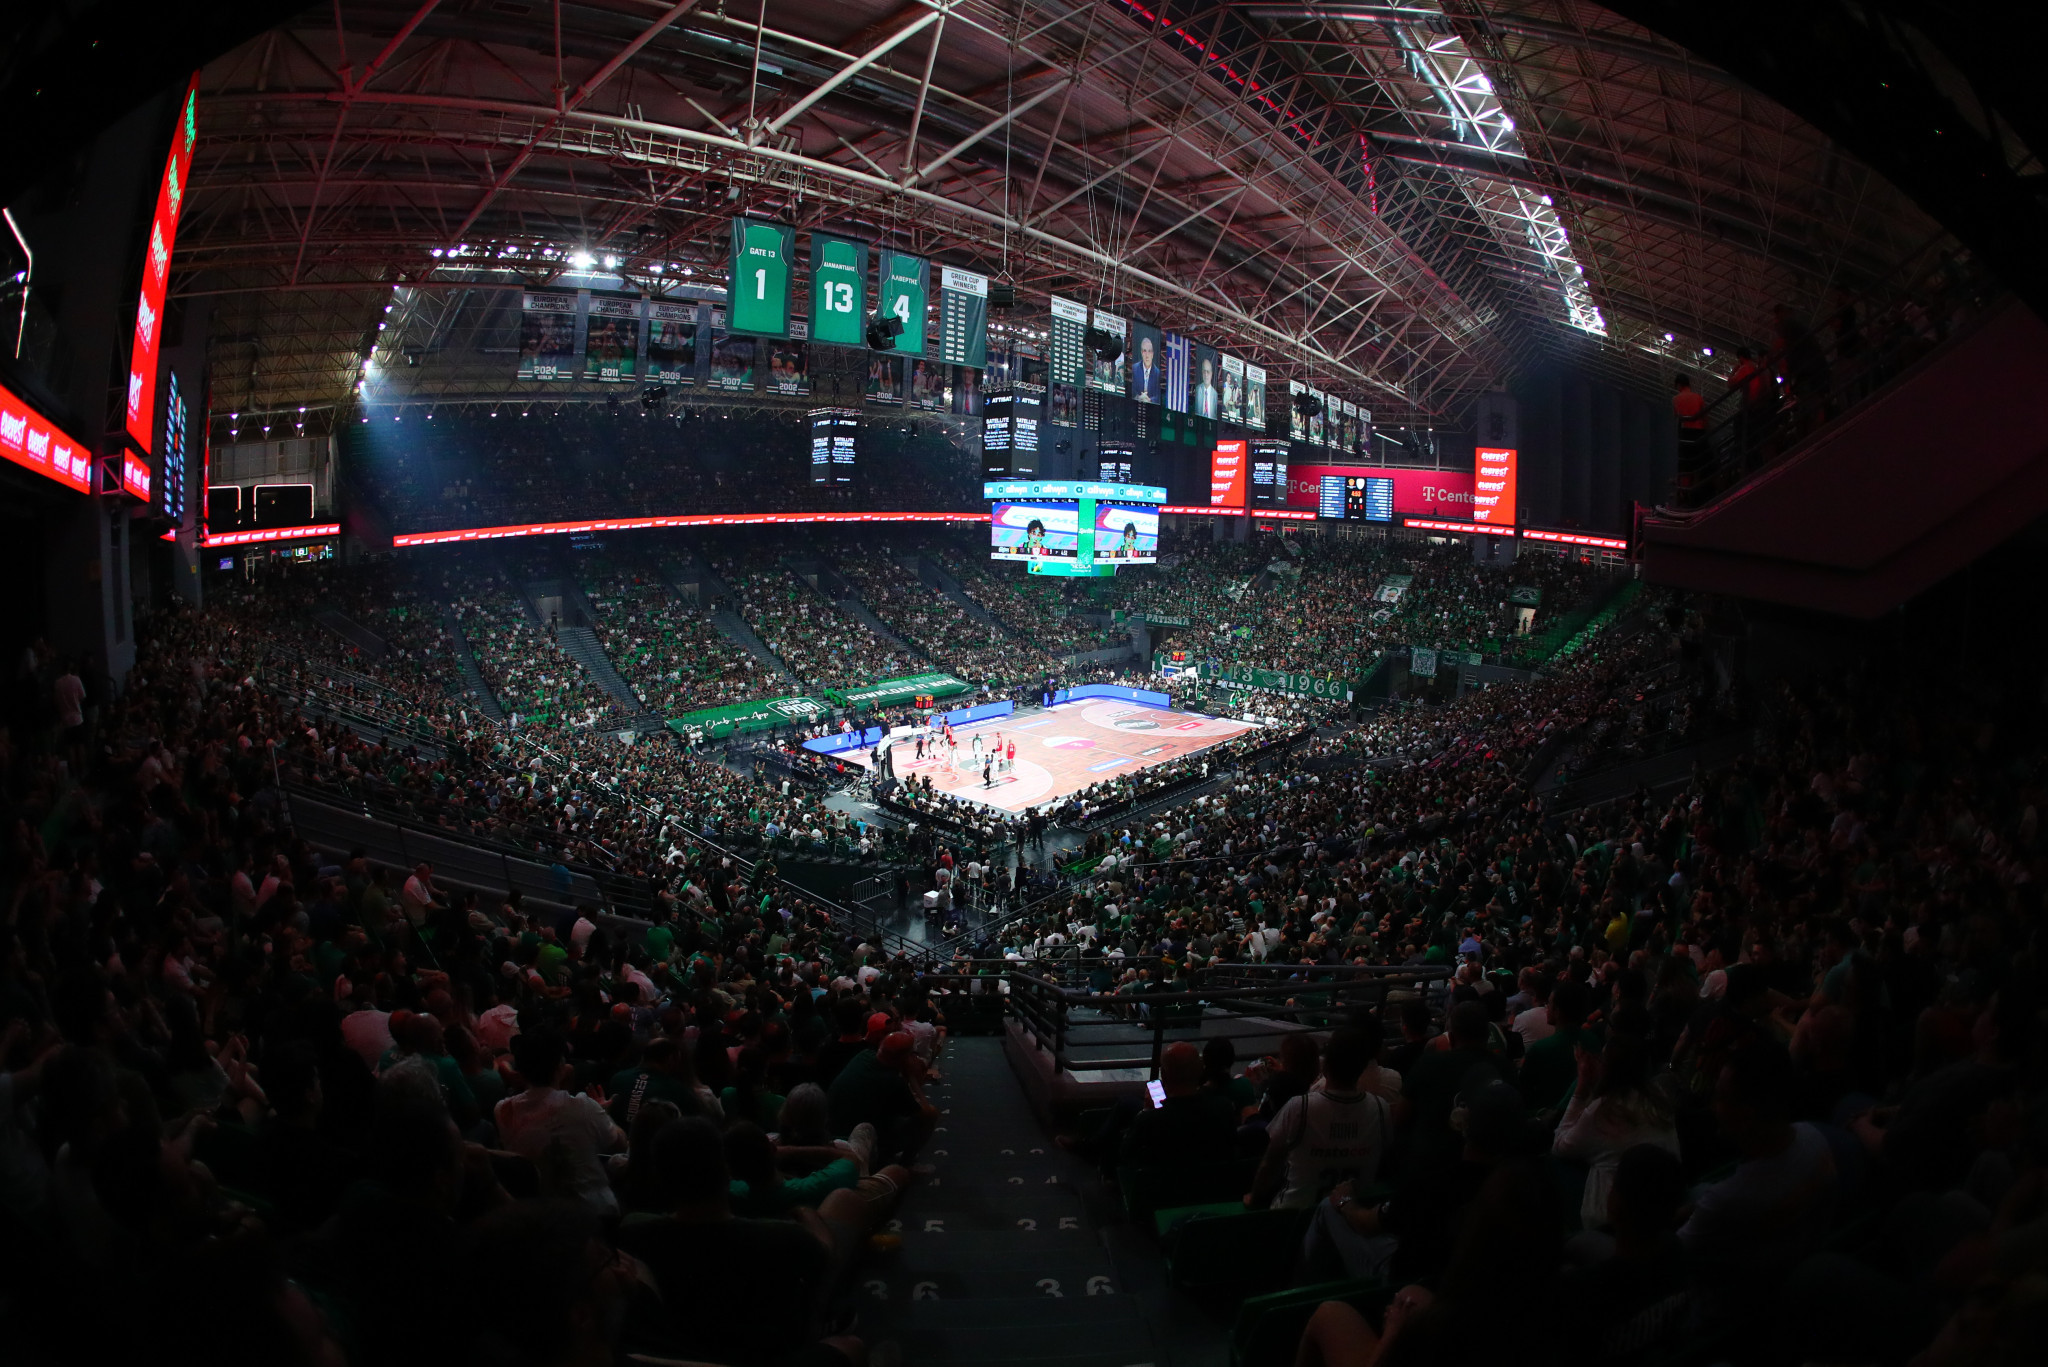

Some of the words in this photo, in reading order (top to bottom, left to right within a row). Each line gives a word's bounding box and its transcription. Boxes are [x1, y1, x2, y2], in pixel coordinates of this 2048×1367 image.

[750, 247, 767, 257] GATE
[768, 250, 776, 258] 13
[951, 272, 968, 282] GREEK
[968, 276, 980, 284] CUP
[755, 269, 766, 300] 1
[952, 279, 978, 291] WINNERS
[534, 295, 568, 304] EUROPEAN
[824, 281, 853, 313] 13
[530, 302, 570, 311] CHAMPIONS
[599, 301, 632, 309] EUROPEAN
[893, 294, 910, 323] 4
[596, 307, 634, 316] CHAMPIONS
[659, 306, 690, 314] EUROPEAN
[656, 312, 691, 320] CHAMPIONS
[534, 366, 557, 375] 2024
[601, 368, 619, 377] 2011
[660, 371, 680, 380] 2009
[721, 377, 741, 386] 2007
[779, 382, 798, 391] 2002
[1103, 383, 1116, 392] 1996
[0, 410, 27, 446] everest
[28, 428, 50, 459] everest
[1217, 443, 1240, 451] everest
[1217, 456, 1240, 464] everest
[1481, 452, 1510, 461] everest
[1214, 469, 1237, 477] everest
[1480, 467, 1509, 476] everest
[1006, 484, 1028, 496] allwyn
[1043, 484, 1067, 496] allwyn
[1087, 485, 1114, 497] allwyn
[1478, 481, 1506, 491] everest
[1146, 614, 1190, 625] PATISSIA
[847, 686, 916, 701] DOWNLOAD
[929, 678, 958, 687] NOW
[1289, 675, 1340, 696] 1966
[683, 724, 702, 732] One
[706, 717, 730, 730] Club
[751, 711, 769, 720] App
